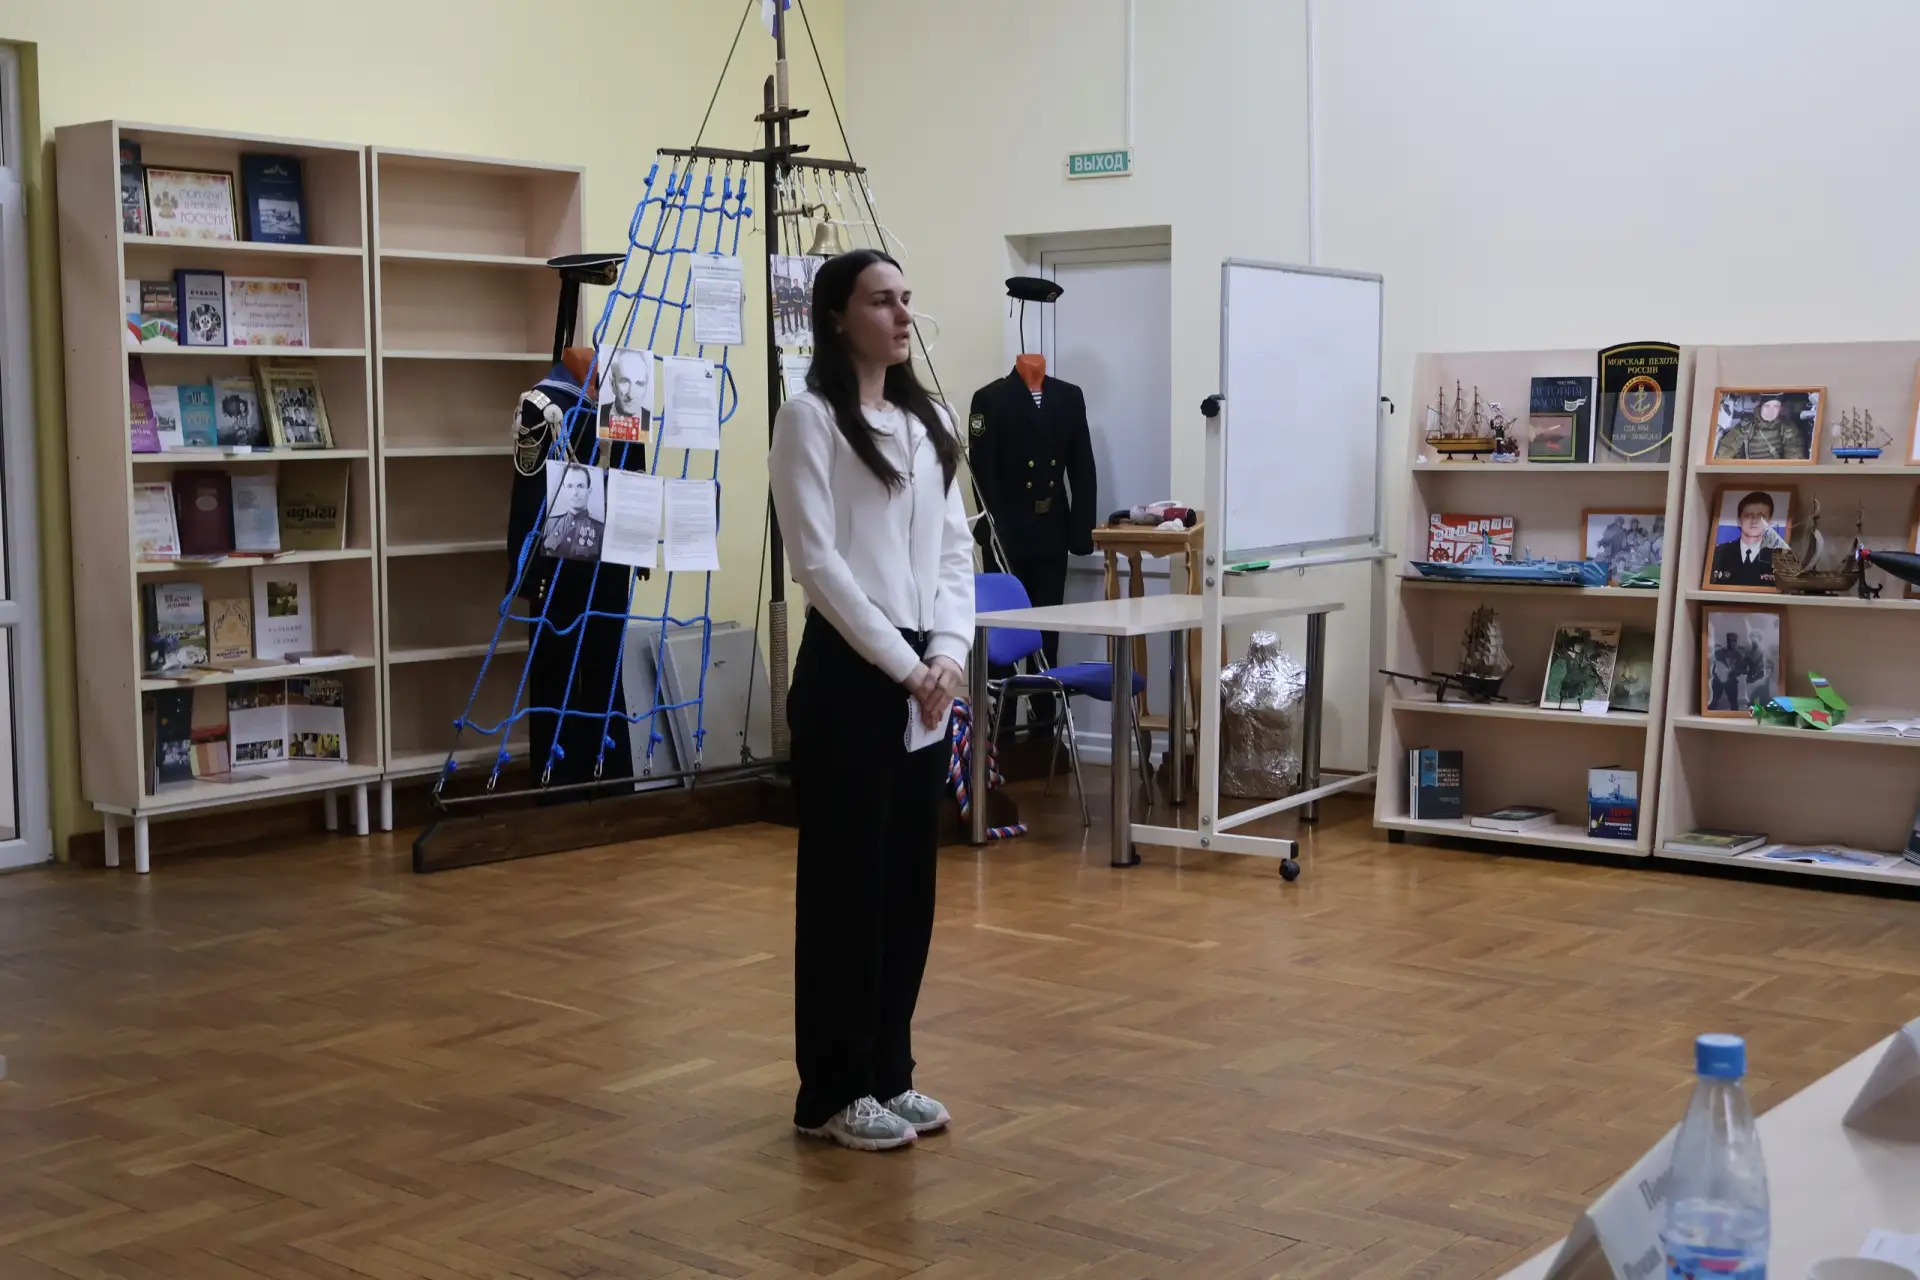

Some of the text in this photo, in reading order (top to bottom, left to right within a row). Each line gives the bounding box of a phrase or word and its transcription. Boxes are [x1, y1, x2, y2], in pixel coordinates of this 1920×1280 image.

[1074, 152, 1124, 172] ВЫХОД
[1607, 358, 1645, 366] МОРСКАЯ
[1627, 366, 1658, 374] РОССИИ
